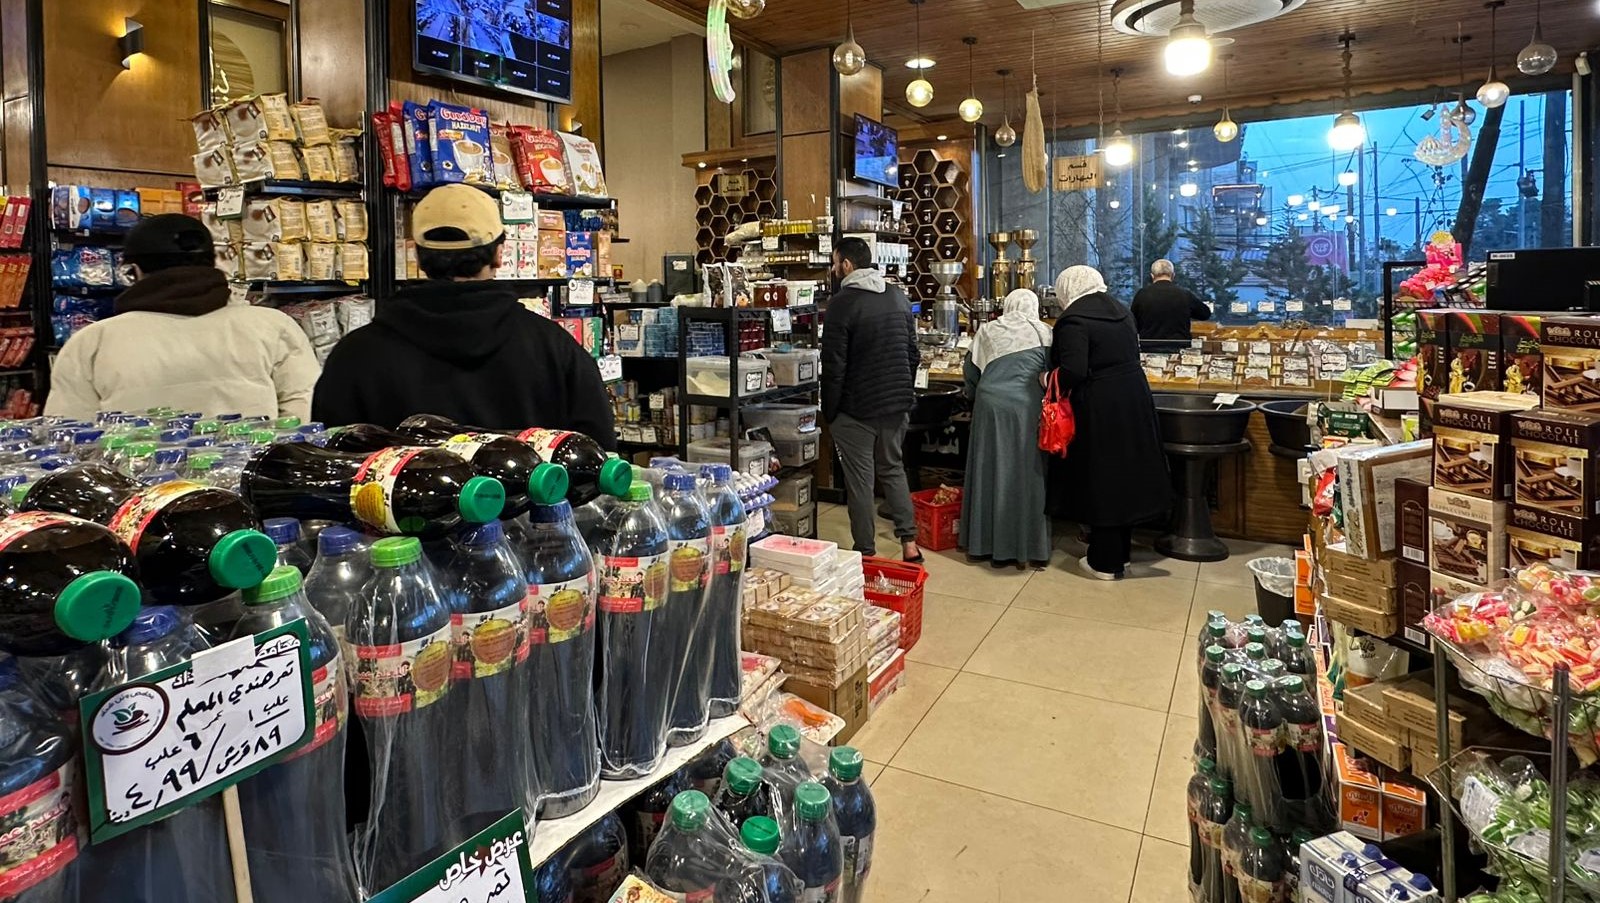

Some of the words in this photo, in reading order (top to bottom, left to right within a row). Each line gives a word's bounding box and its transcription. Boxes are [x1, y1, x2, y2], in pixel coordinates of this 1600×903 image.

[1067, 159, 1087, 170] قسم
[1058, 172, 1097, 183] البهارات
[1439, 417, 1493, 431] CHOCOLATE
[1463, 413, 1492, 424] ROLL
[1519, 429, 1579, 445] CHOCOLATE
[1545, 425, 1579, 437] ROLL
[1513, 518, 1574, 538] CHOCOLATE
[1540, 515, 1574, 530] ROLL
[485, 830, 524, 866] عرض
[439, 851, 482, 890] خاص
